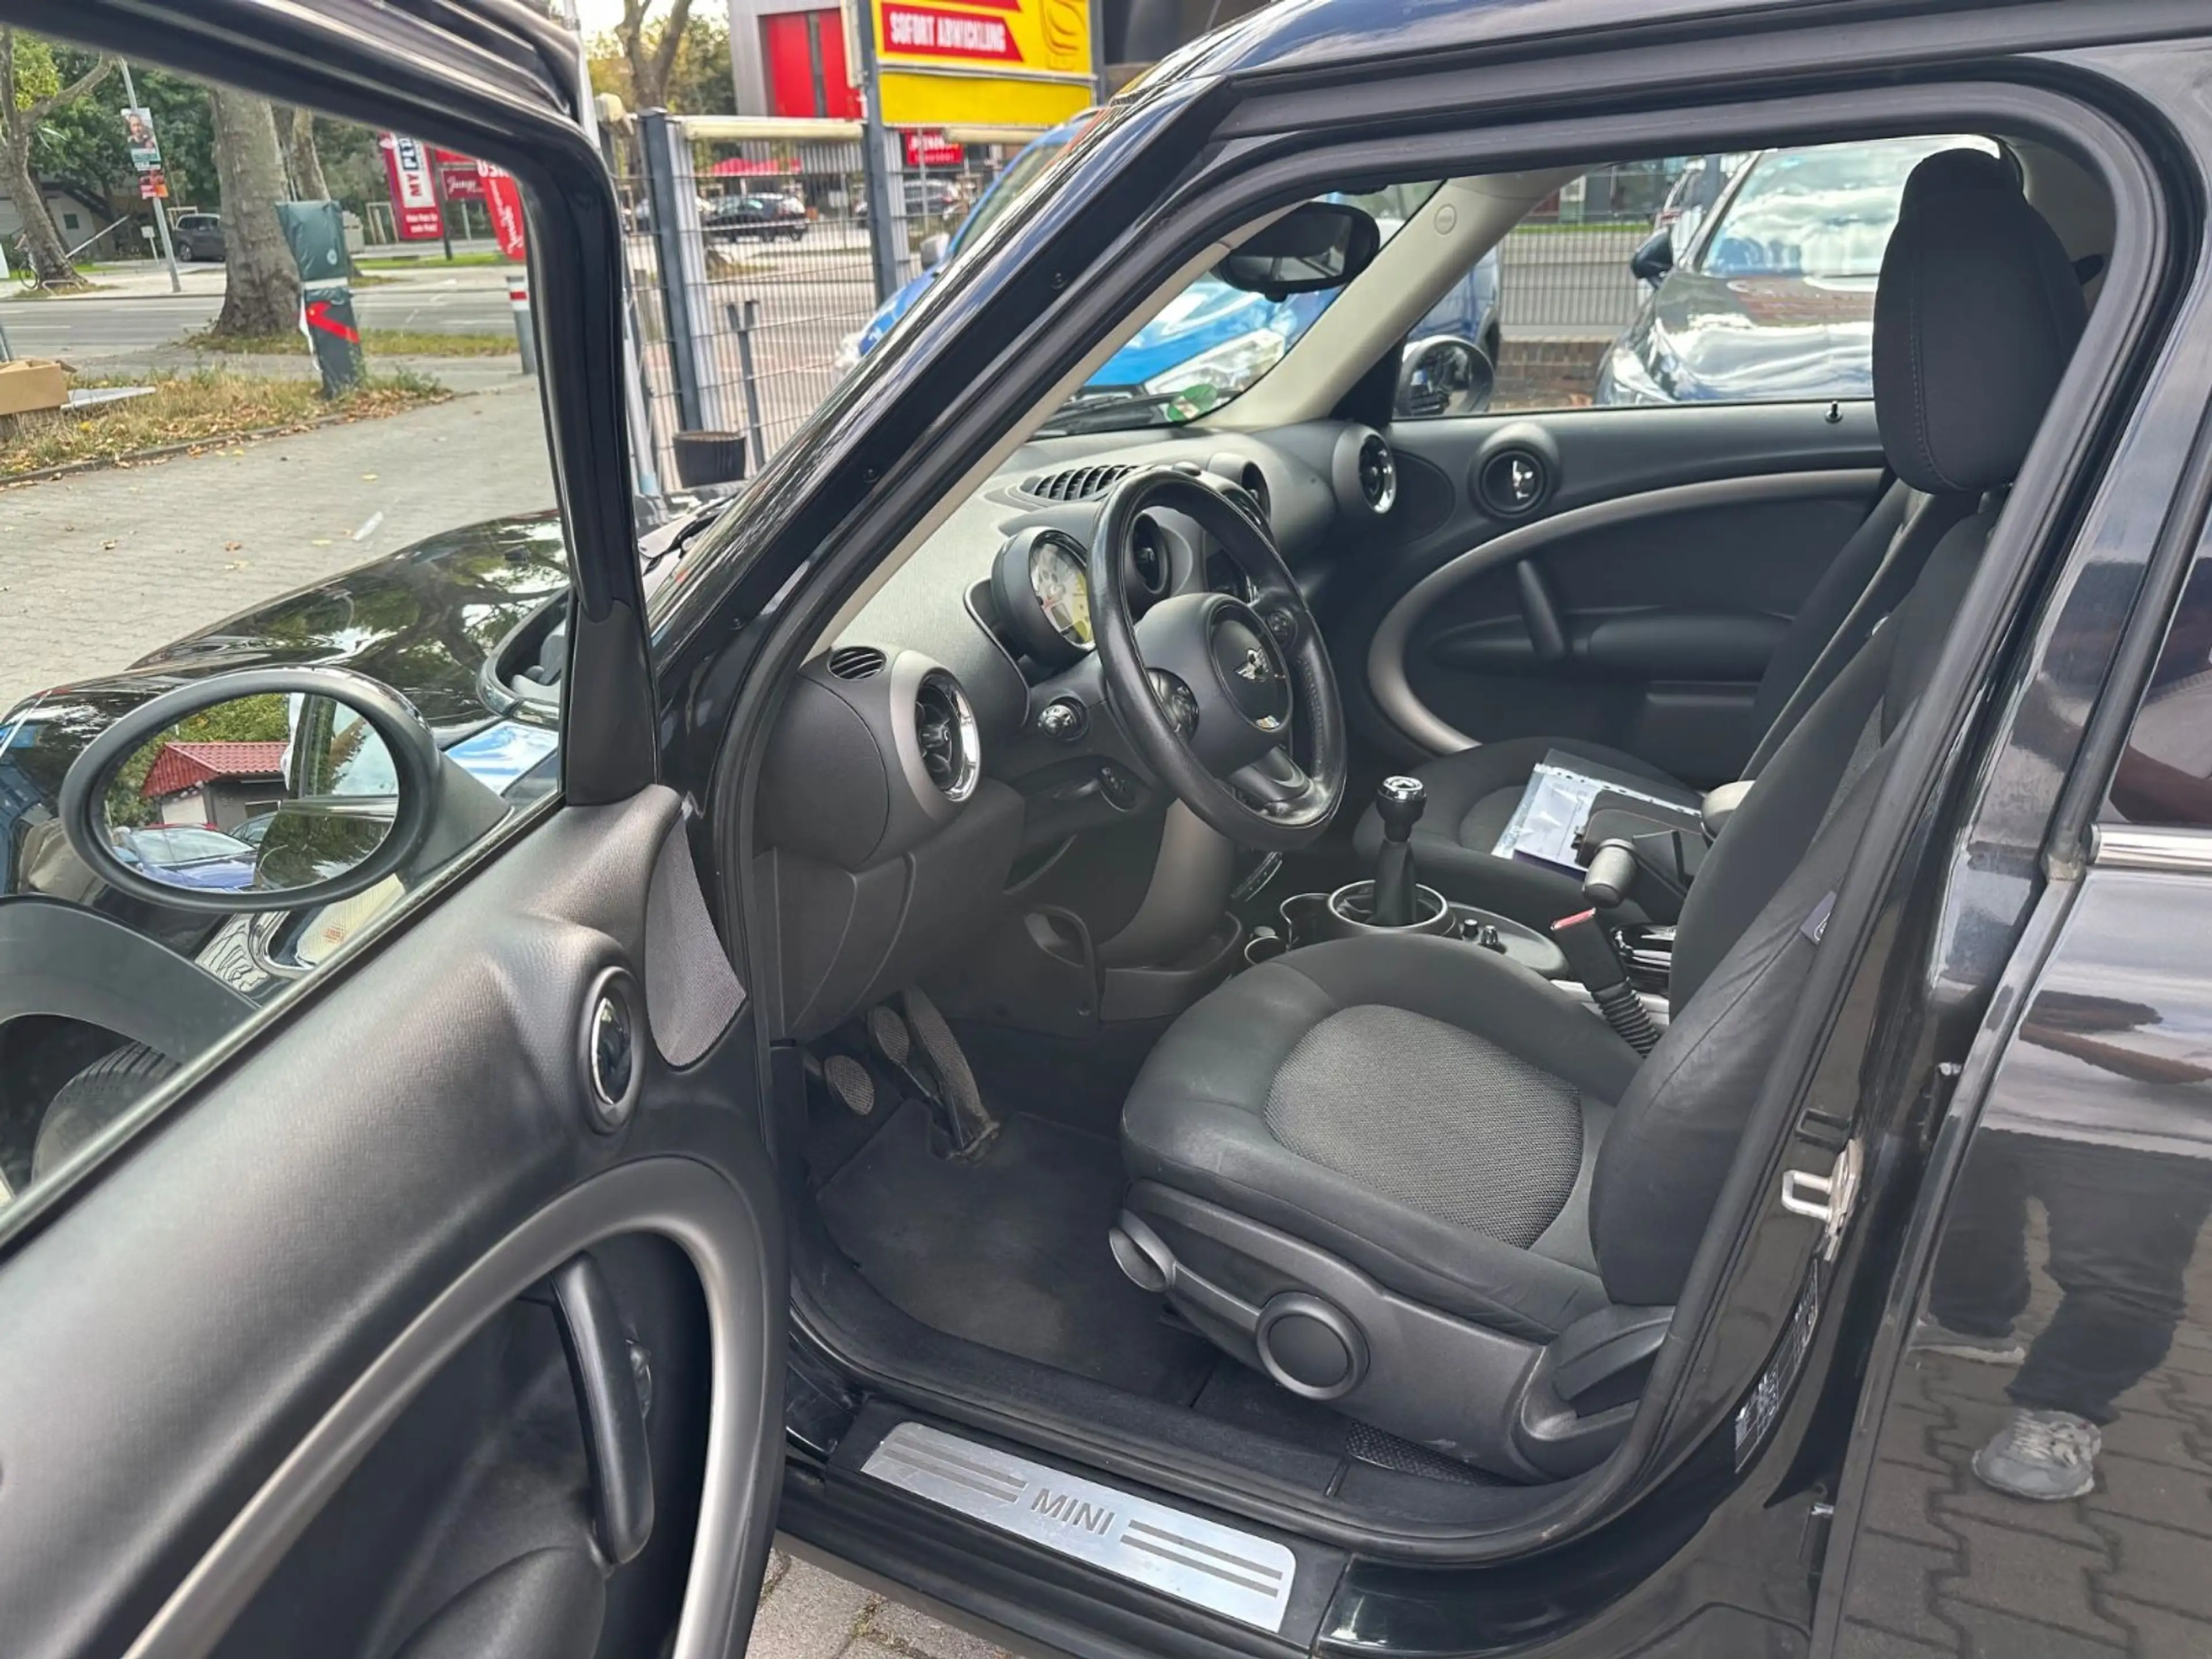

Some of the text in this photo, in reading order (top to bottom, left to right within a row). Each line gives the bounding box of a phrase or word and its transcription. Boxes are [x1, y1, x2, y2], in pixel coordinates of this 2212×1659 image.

[889, 12, 1006, 52] SOFORT ABWICKLUNG
[406, 174, 422, 196] MY
[1031, 1487, 1116, 1535] MINI
